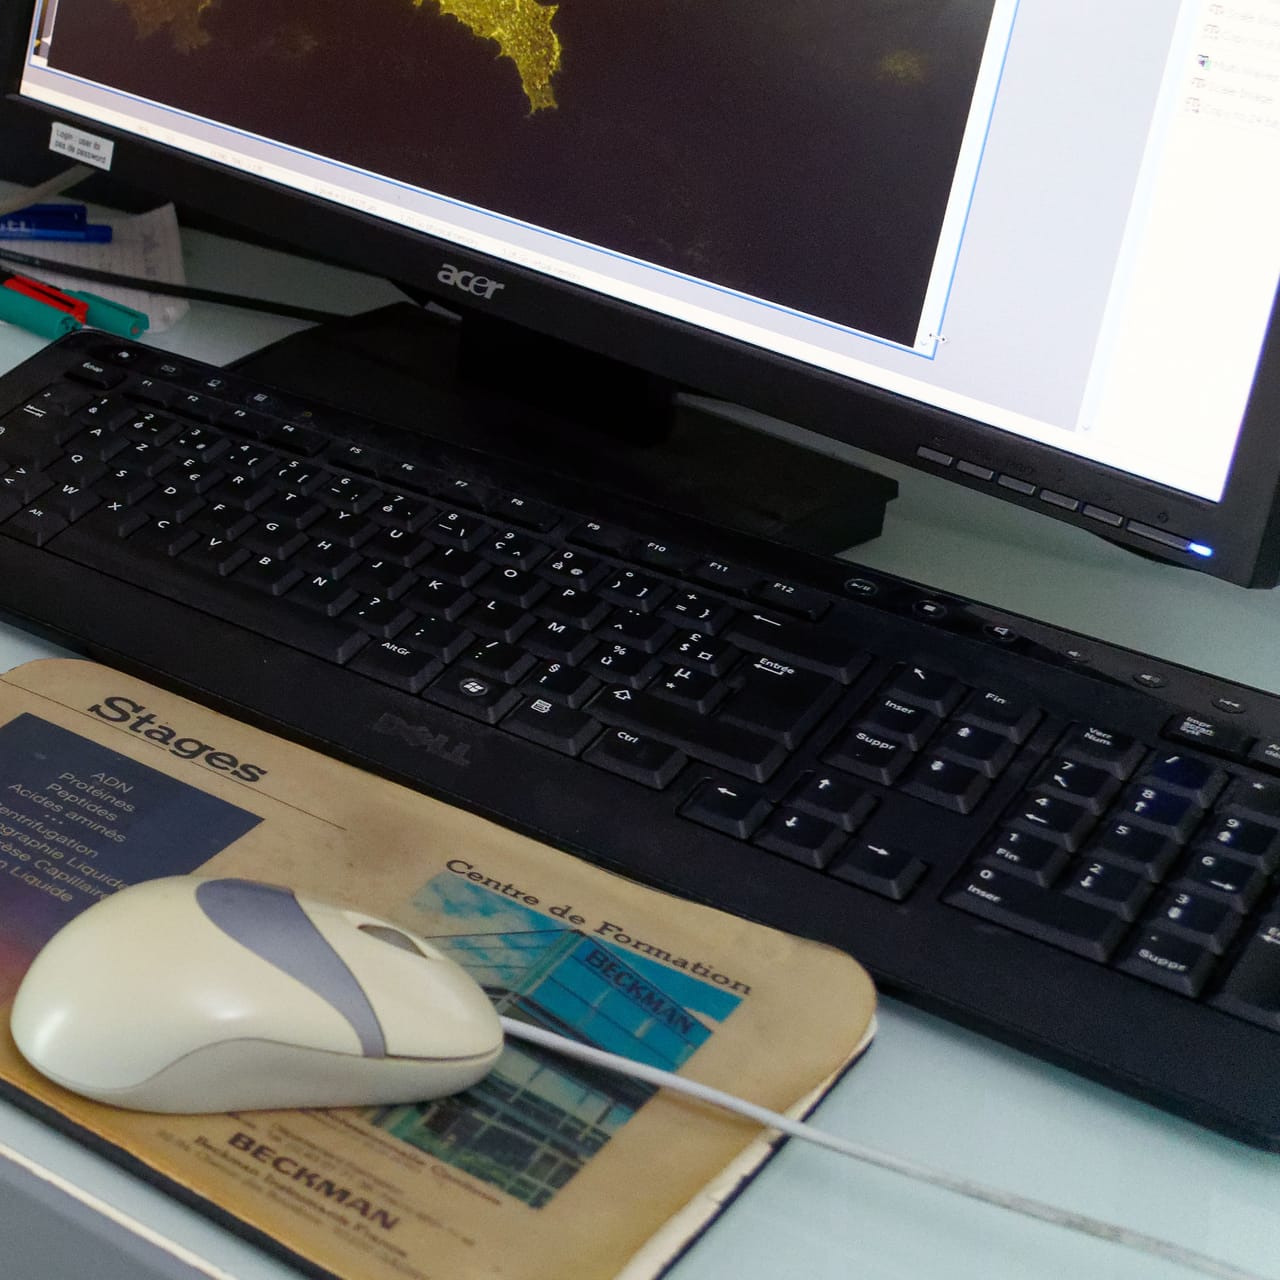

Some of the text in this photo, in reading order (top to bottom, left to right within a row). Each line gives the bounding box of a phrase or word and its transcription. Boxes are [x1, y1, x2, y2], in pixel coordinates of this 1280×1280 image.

[437, 263, 505, 300] acer
[143, 413, 155, 421] 2
[89, 428, 102, 437] A
[190, 428, 201, 436] 3
[135, 442, 149, 452] Z
[349, 446, 362, 454] F5
[71, 454, 84, 464] Q
[183, 458, 196, 467] E
[288, 460, 300, 468] 5
[401, 463, 415, 471] F6
[115, 469, 128, 478] S
[232, 475, 245, 485] R
[340, 477, 351, 485] 6
[455, 480, 469, 488] F7
[62, 484, 80, 495] W
[163, 486, 177, 495] D
[285, 492, 297, 501] T
[107, 501, 123, 511] X
[213, 503, 226, 511] F
[510, 498, 525, 506] F8
[28, 508, 44, 518] Alt
[338, 510, 351, 520] Y
[447, 513, 459, 521] 8
[157, 520, 171, 529] C
[265, 522, 280, 532] G
[586, 522, 601, 531] F9
[389, 529, 404, 539] U
[504, 532, 516, 540] 9
[209, 537, 223, 546] V
[317, 540, 332, 550] H
[647, 542, 667, 553] F10
[258, 556, 272, 565] B
[371, 561, 383, 569] J
[709, 561, 729, 572] F11
[503, 568, 518, 578] O
[312, 576, 328, 587] N
[428, 579, 444, 590] K
[562, 588, 576, 597] P
[773, 582, 795, 594] F12
[486, 600, 496, 610] L
[547, 621, 567, 634] M
[381, 642, 411, 656] AltGr
[613, 645, 627, 656] %
[984, 692, 1007, 705] Fin
[884, 699, 915, 714] Inser
[87, 695, 268, 783] Stages
[617, 731, 639, 744] Ctrl
[855, 732, 896, 750] Suppr
[1083, 732, 1112, 746] Num
[1061, 761, 1075, 770] 7
[90, 772, 134, 793] ADN
[58, 772, 135, 812] Protéines
[1141, 788, 1156, 799] 8
[45, 783, 118, 821] Peptides
[1034, 797, 1049, 807] 4
[7, 783, 127, 842] Acides aminés
[1226, 818, 1240, 828] 9
[1115, 824, 1129, 835] 5
[1009, 832, 1019, 842] 1
[995, 847, 1020, 862] Fin
[1201, 855, 1215, 866] 6
[1089, 863, 1104, 875] 2
[979, 869, 994, 880] 0
[9, 866, 73, 902] Liquide
[967, 884, 1001, 902] Inser
[1175, 893, 1190, 905] 3
[446, 859, 752, 996] Centre de Formation
[1138, 948, 1186, 971] Suppr
[586, 949, 694, 1033] BECKMAN
[228, 1131, 400, 1230] BECKMAN
